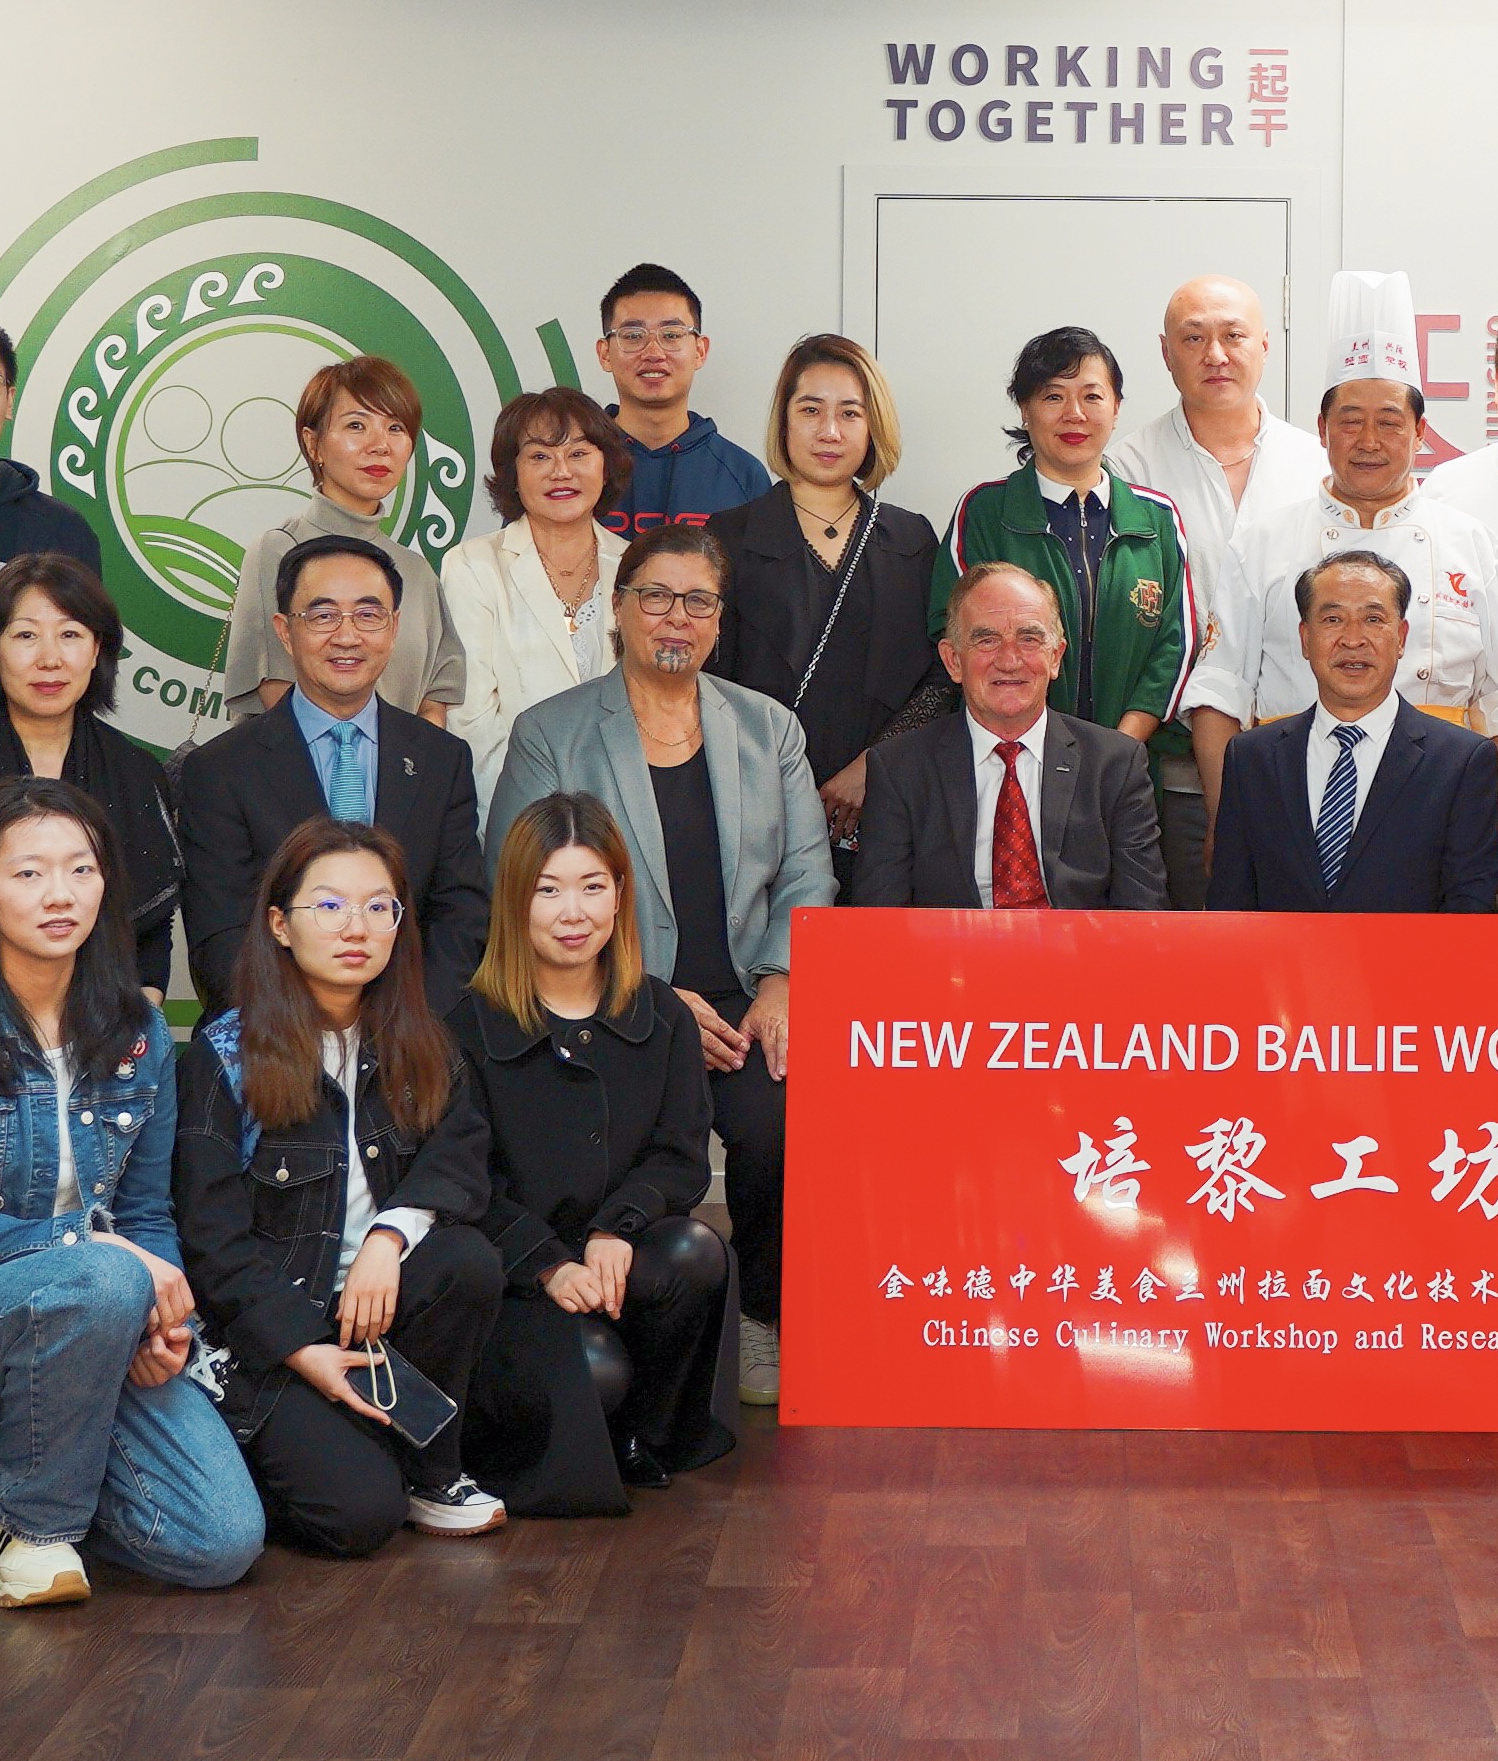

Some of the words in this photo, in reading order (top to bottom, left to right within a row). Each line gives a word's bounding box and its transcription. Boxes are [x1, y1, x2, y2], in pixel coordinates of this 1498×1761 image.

[884, 44, 1225, 89] WORKING
[1249, 48, 1289, 147] 一起干
[885, 99, 1234, 146] TOGETHER
[851, 1021, 973, 1069] NEW
[987, 1022, 1239, 1071] ZEALAND
[1258, 1024, 1418, 1072] BAILIE
[923, 1320, 1039, 1347] Chinese
[1056, 1321, 1189, 1353] Culinary
[1205, 1323, 1338, 1354] Workshop
[1355, 1324, 1404, 1350] and
